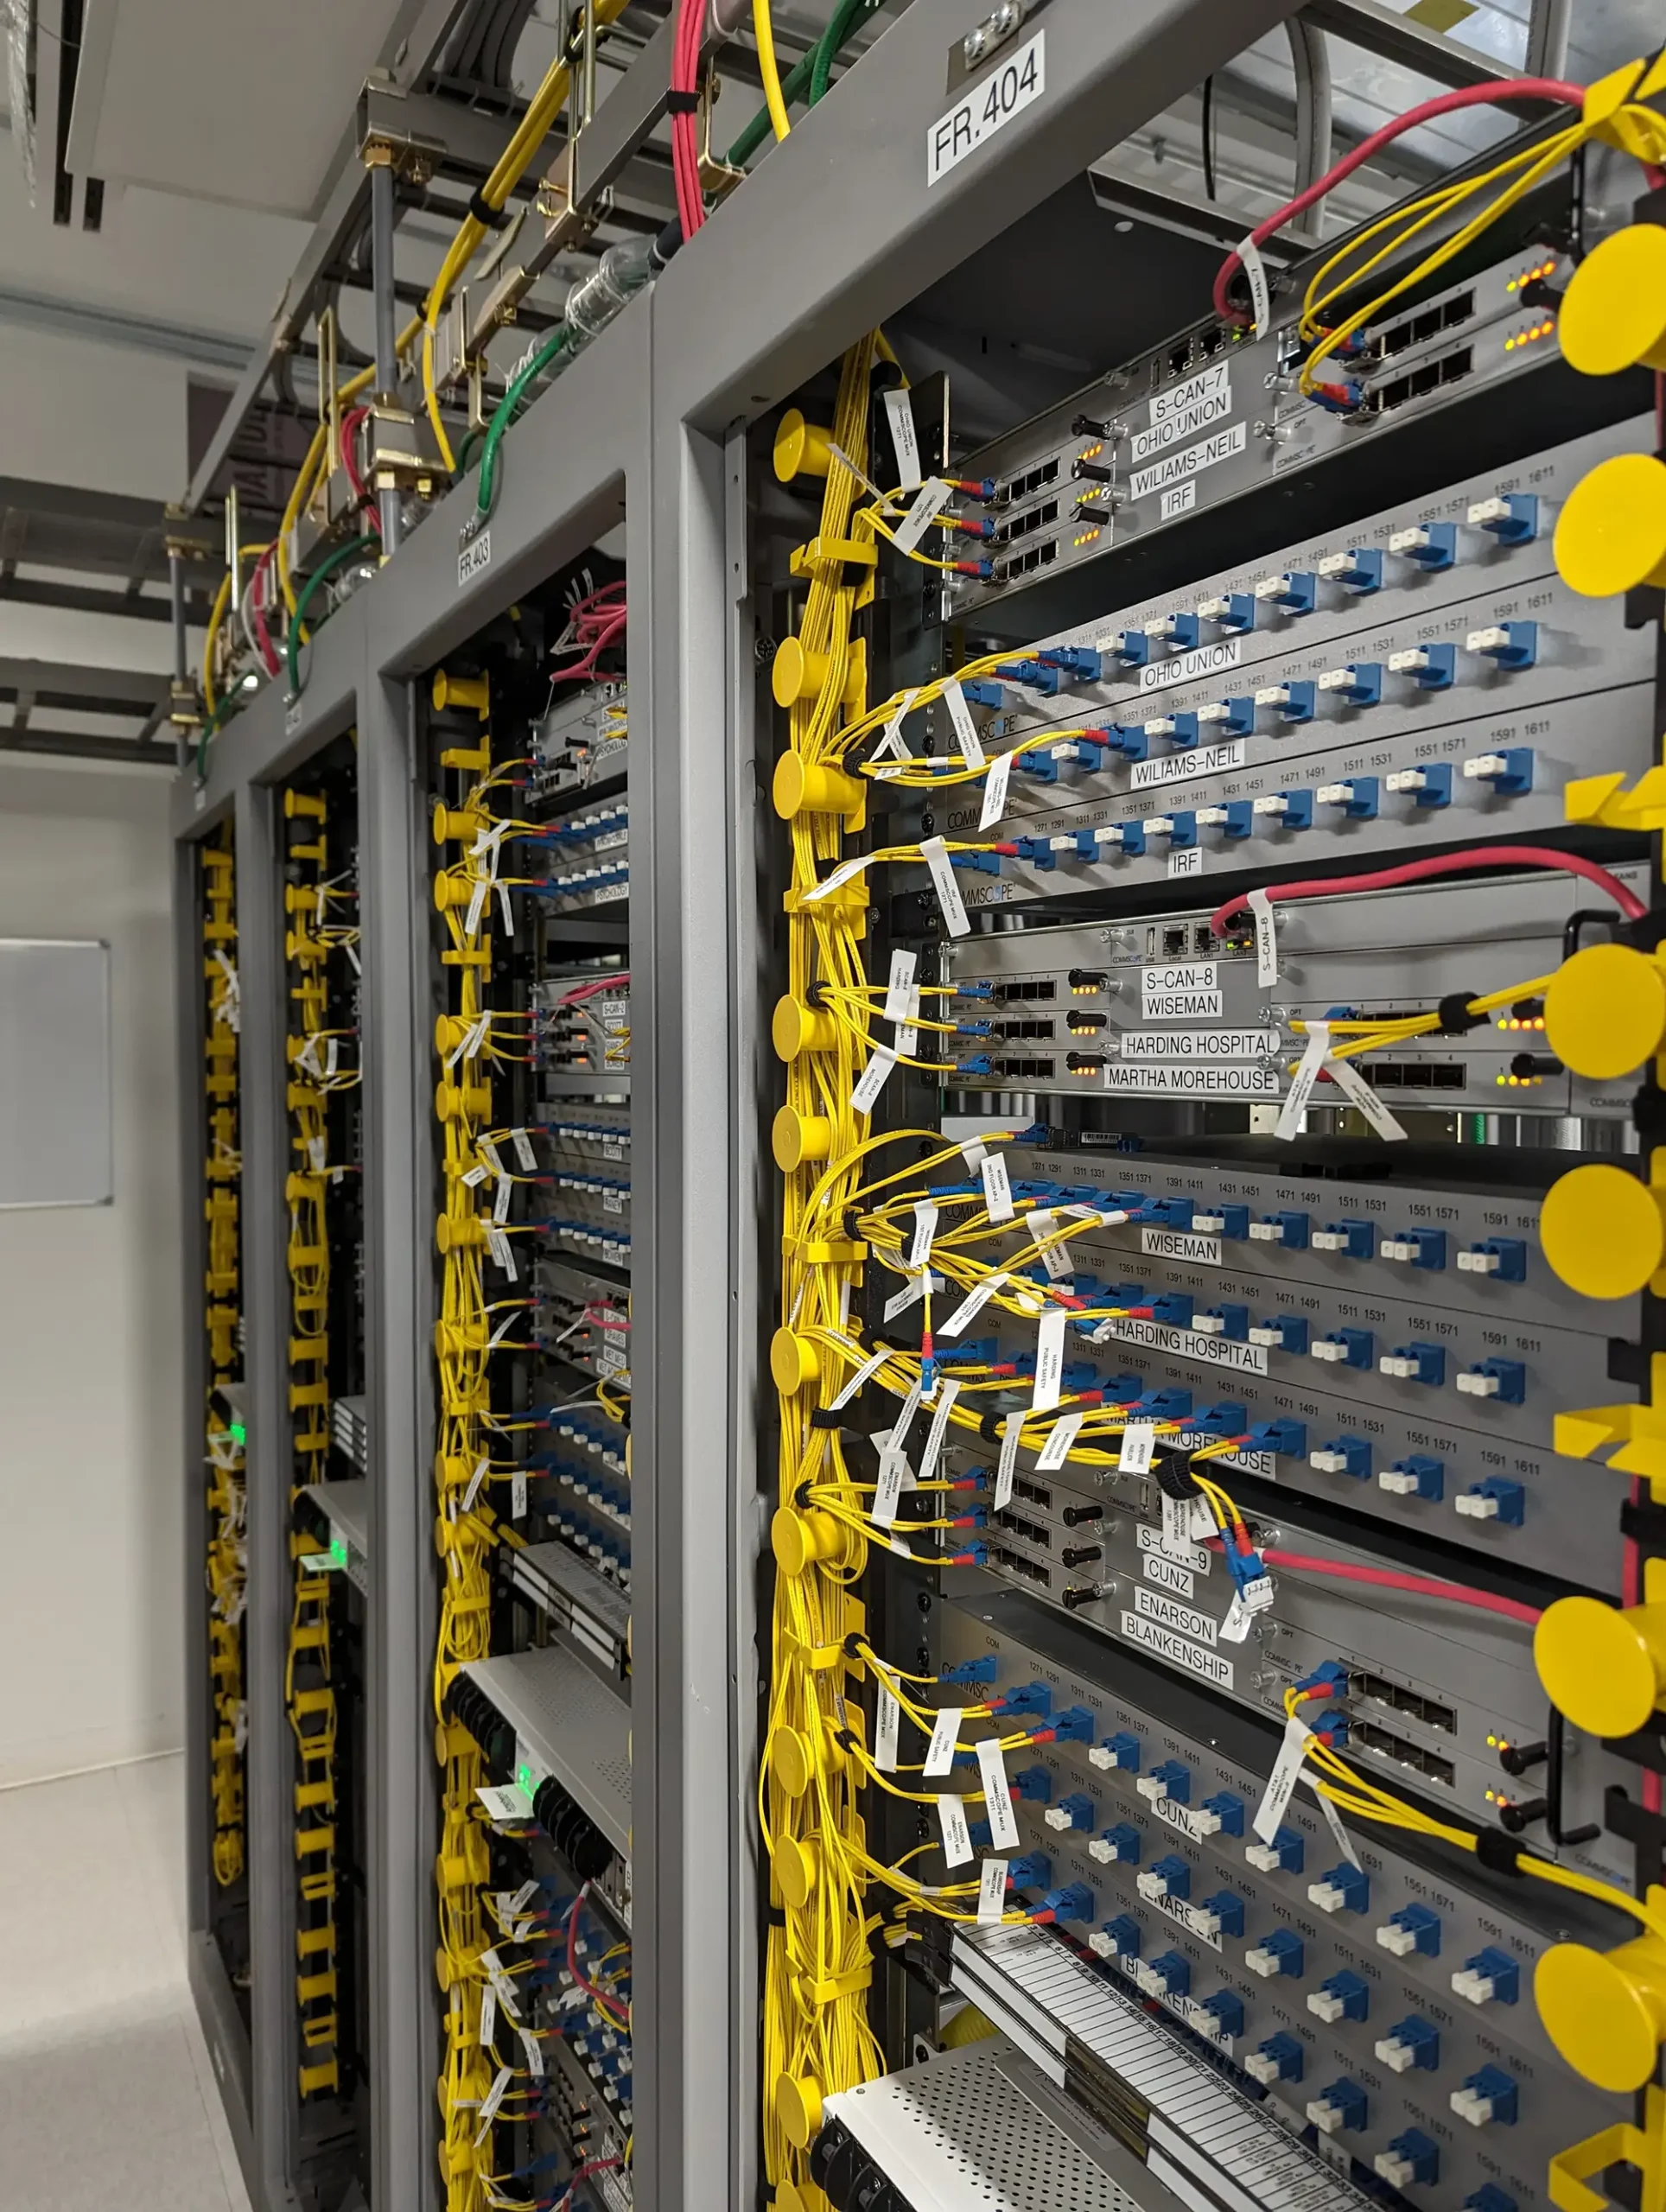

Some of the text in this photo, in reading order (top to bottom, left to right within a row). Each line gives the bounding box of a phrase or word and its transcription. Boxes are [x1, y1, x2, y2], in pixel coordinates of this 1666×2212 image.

[936, 48, 1038, 171] FR.404
[1156, 367, 1224, 418] S-CAN-7
[897, 404, 908, 442] COMMSCOPE
[1137, 393, 1226, 454] OHIO UNION
[1136, 436, 1241, 493] WILIAMS-NEIL
[1167, 487, 1191, 513] IRF
[460, 537, 489, 580] FR.403
[1145, 644, 1236, 686] OHIO UNION
[1122, 721, 1550, 816] 1351 1371 1391 1411 1431 1451 1471 1491 1511 1531 1551 1571 1591 1611
[1135, 745, 1240, 783] WILIAMS-NEIL
[1173, 853, 1198, 873] IRF
[938, 871, 957, 906] COMMSCOPE
[1260, 917, 1271, 971] S-CAN-8
[1147, 968, 1213, 989] S-CAN-8
[1148, 995, 1218, 1014] WISEMAN
[1127, 1037, 1192, 1054] HARDING
[1197, 1035, 1274, 1054] HOSPITAL
[1110, 1068, 1274, 1090] MARTHA MOREHOUSE
[995, 1169, 1006, 1191] WISEMAN
[1118, 1172, 1508, 1225] 1351 1371 1391 1411 1431 1451 1471 1491 1511 1531 1551 1571 1591
[1147, 1232, 1217, 1260] WISEMAN
[1118, 1263, 1541, 1352] 1351 1371 1391 1411 1431 1451 1471 1491 1511 1531 1551 1571 1591 1611
[1116, 1319, 1262, 1370] HARDING HOSPITAL
[1118, 1355, 1505, 1466] 1351 1371 1391 1411 1431 1451 1471 1491 1511 1531 1551 1571 1591
[1168, 1432, 1270, 1474] MOREOUSE
[1142, 1529, 1206, 1569] S-C-9
[1149, 1560, 1189, 1592] CUNZ
[1141, 1593, 1211, 1640] ENARSON
[986, 1637, 999, 1649] COM
[1127, 1619, 1229, 1680] BLANKENSHIP
[881, 1690, 889, 1726] COMMSCOPE
[1089, 1695, 1256, 1797] 1331 1351 1371 1391 1411 1431 1451
[989, 1775, 1004, 1816] COMMSCOPE
[1000, 1793, 1008, 1811] CUNZ
[948, 1814, 961, 1843] COMMSCOPE
[957, 1821, 966, 1844] ENARSON
[1088, 1783, 1291, 1921] 1331 1351 1371 1391 1411 1431 1451 1471
[1088, 1872, 1232, 1983] 1331 1351 1371 1391 1411 1431
[1146, 1891, 1217, 1944] NARSN
[1174, 2046, 1197, 2063] 19 20
[1196, 2063, 1208, 2072] 21
[1217, 2081, 1240, 2100] 23 24
[1239, 2100, 1251, 2110] 25
